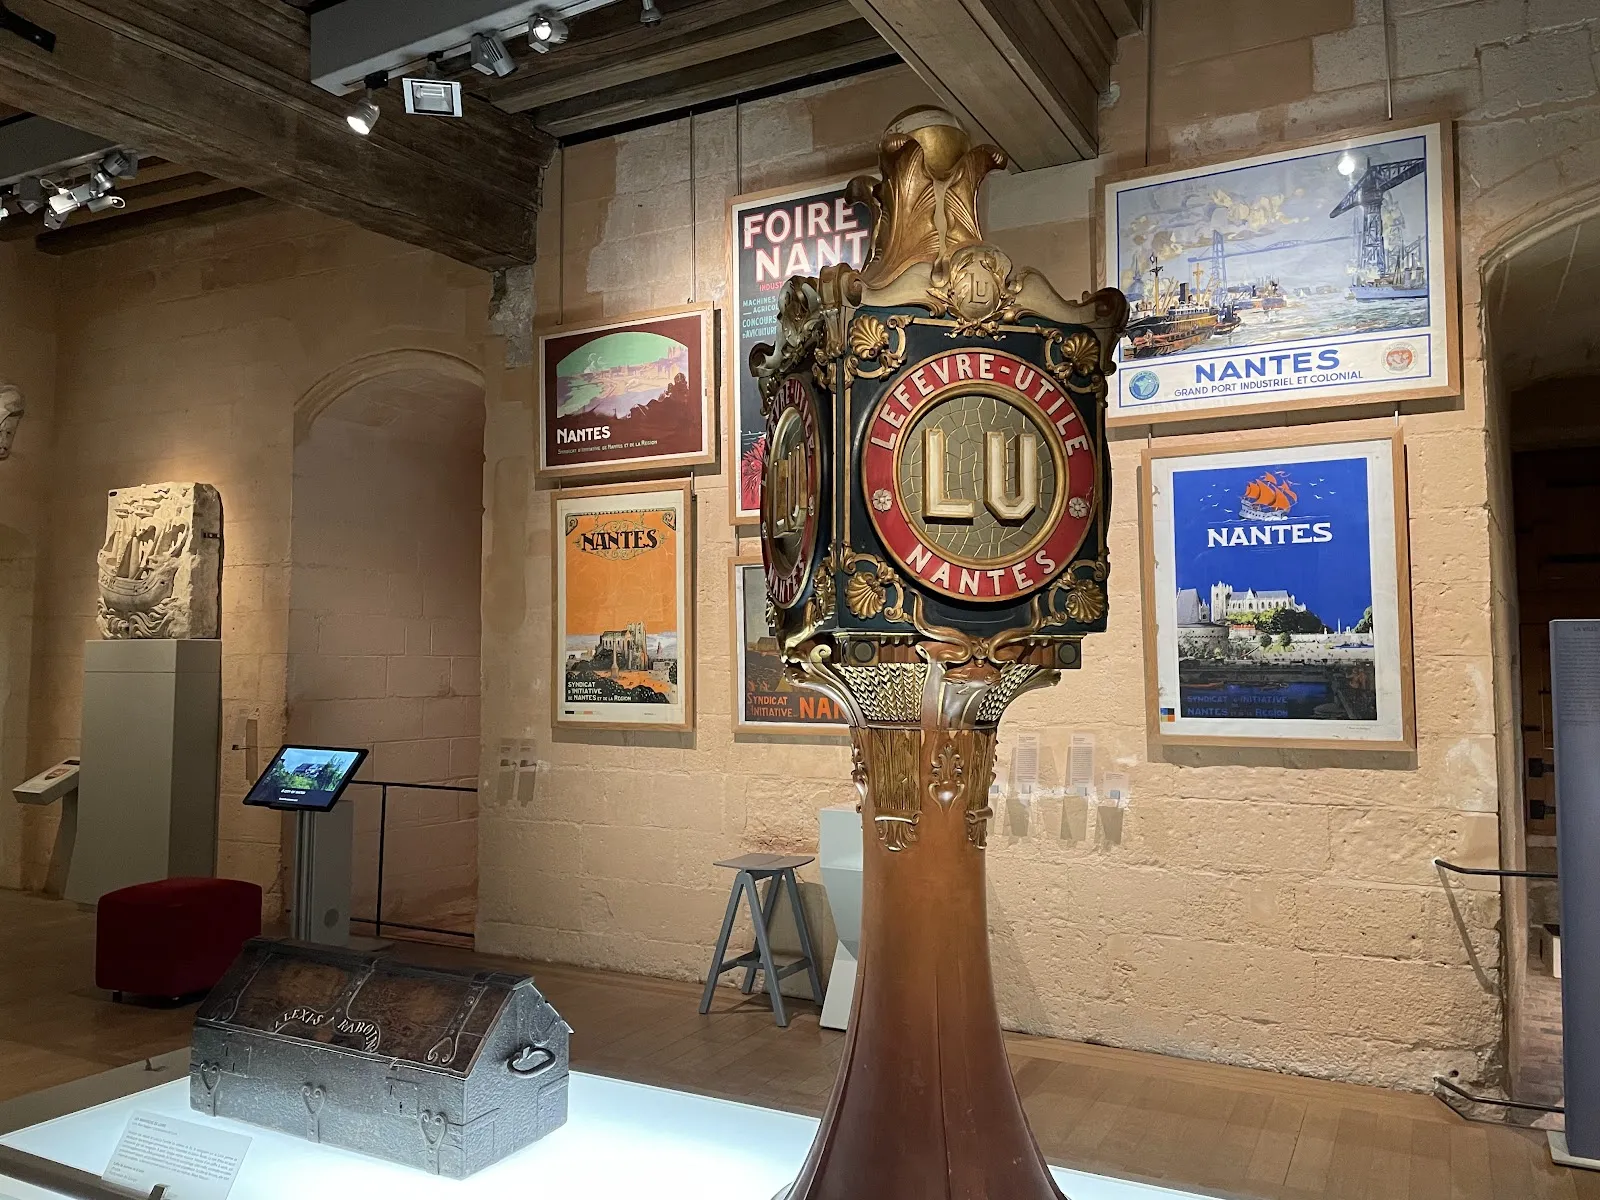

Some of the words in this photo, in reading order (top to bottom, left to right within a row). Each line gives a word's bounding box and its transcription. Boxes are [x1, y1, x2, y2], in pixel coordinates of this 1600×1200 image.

[743, 198, 857, 249] FOIRE
[742, 296, 776, 307] MACHINES
[968, 272, 990, 305] LU
[742, 315, 777, 328] CONCOURS
[1195, 349, 1340, 384] NANTES
[1174, 385, 1208, 397] GRAND
[1211, 382, 1236, 394] PORT
[1240, 377, 1294, 391] INDUSTRIEL
[1297, 375, 1308, 385] ET
[1310, 370, 1363, 384] COLONIAL
[871, 353, 1089, 456] LEFEVRE-UTILE
[556, 426, 611, 444] NANTES
[923, 428, 1037, 520] LU
[580, 528, 658, 551] NANTES
[1207, 522, 1333, 548] NANTES
[905, 544, 1056, 596] NANTES
[747, 692, 788, 706] SYNDICAT
[1187, 695, 1227, 703] SYNDICAT
[1187, 708, 1229, 716] NANTES
